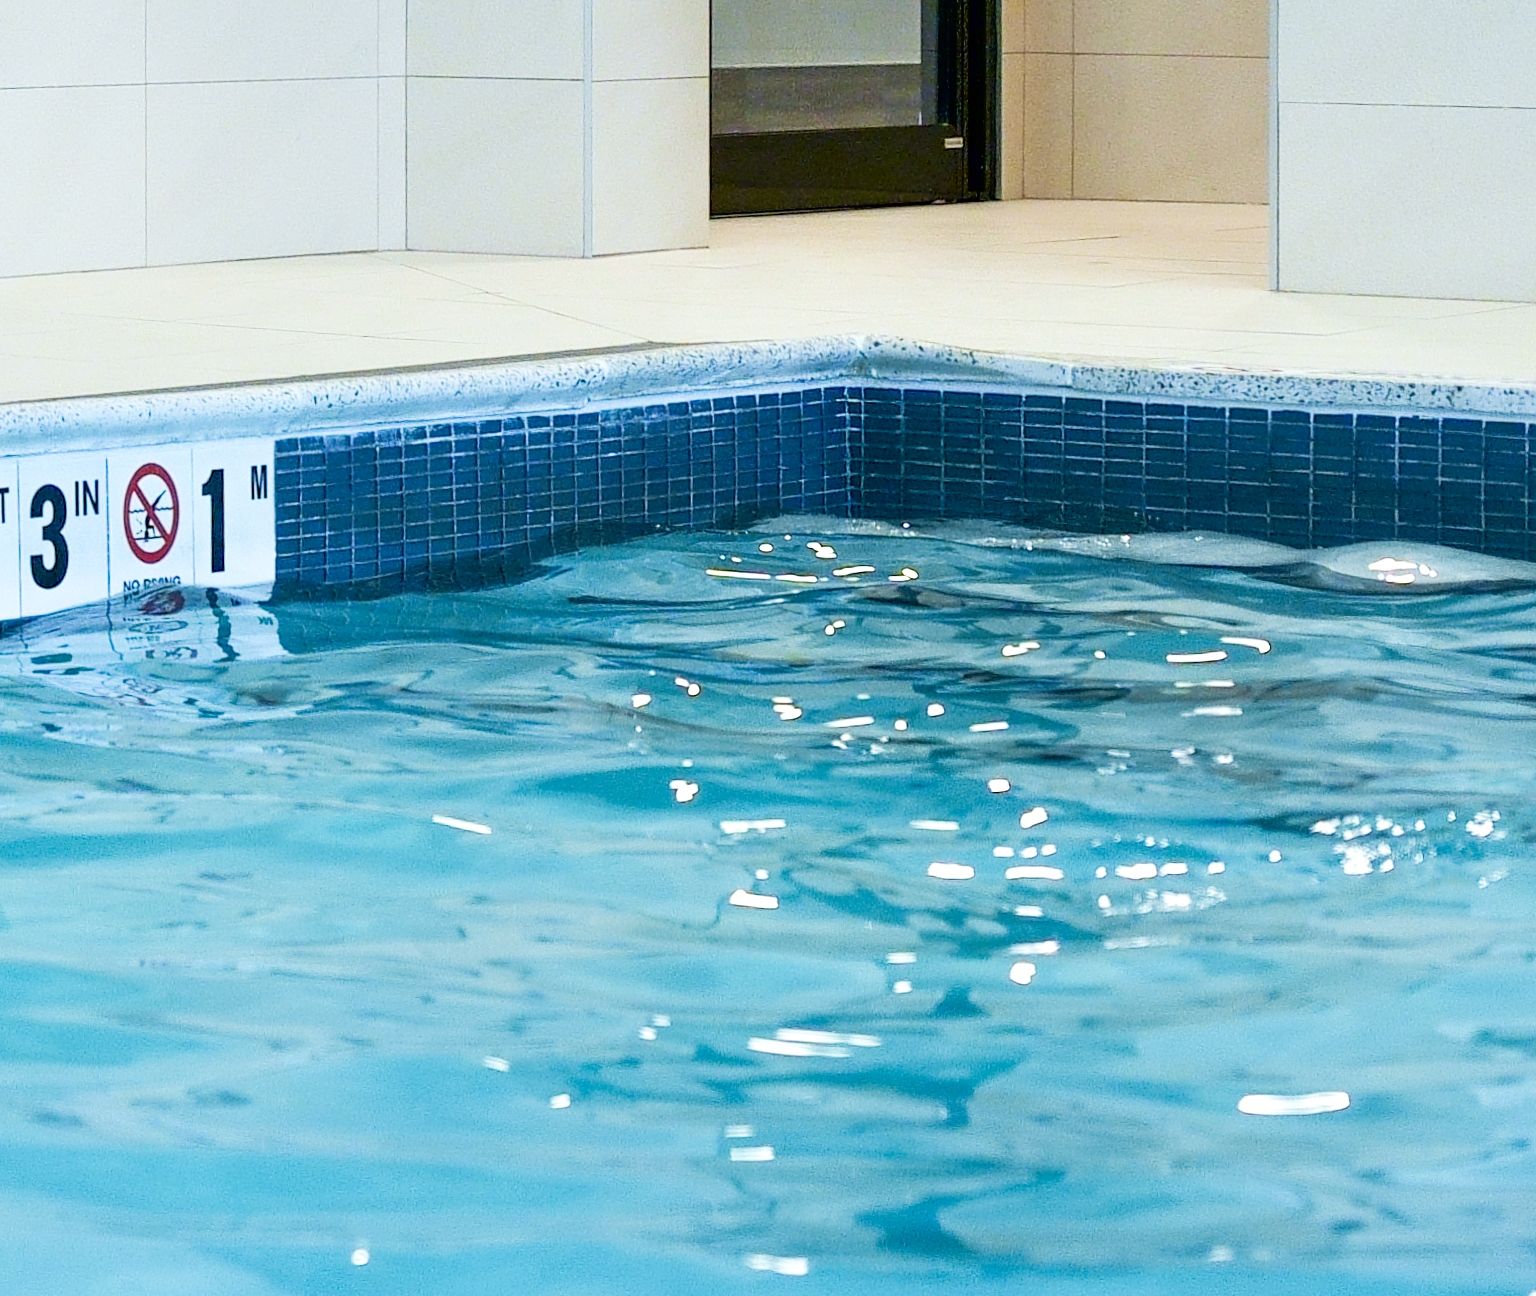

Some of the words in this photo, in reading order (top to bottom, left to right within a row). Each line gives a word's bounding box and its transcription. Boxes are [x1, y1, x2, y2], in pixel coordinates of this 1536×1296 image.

[29, 483, 69, 589] 3
[74, 479, 100, 517] IN
[201, 468, 225, 573] 1
[250, 464, 268, 500] M
